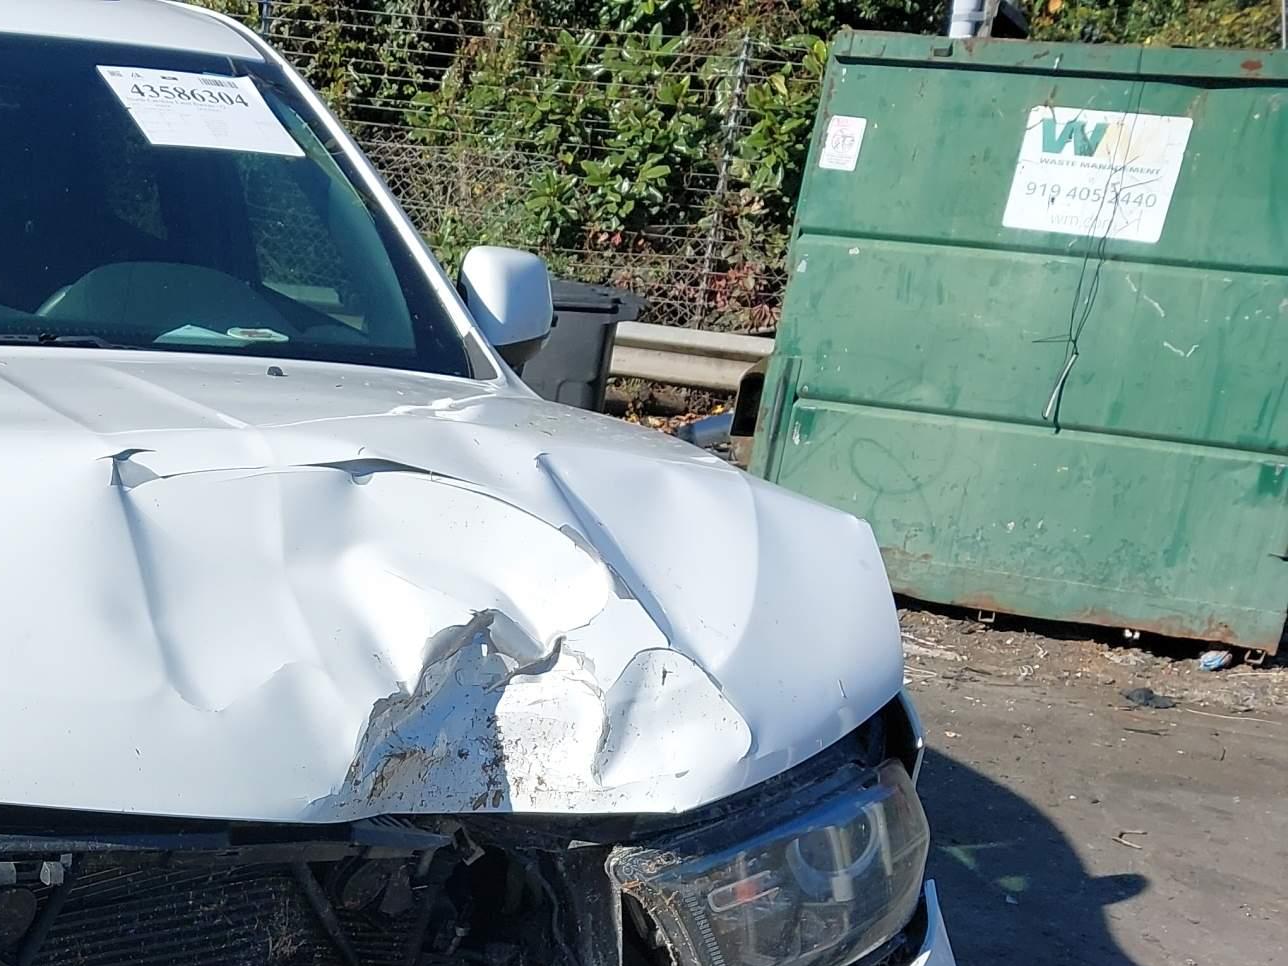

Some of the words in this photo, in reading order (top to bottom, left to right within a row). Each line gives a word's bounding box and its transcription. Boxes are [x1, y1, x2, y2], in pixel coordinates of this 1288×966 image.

[130, 83, 249, 107] 43586304
[1039, 157, 1078, 168] WASTE
[1080, 162, 1161, 176] MANAGMENT
[1025, 181, 1061, 198] 919
[1066, 187, 1101, 202] 405
